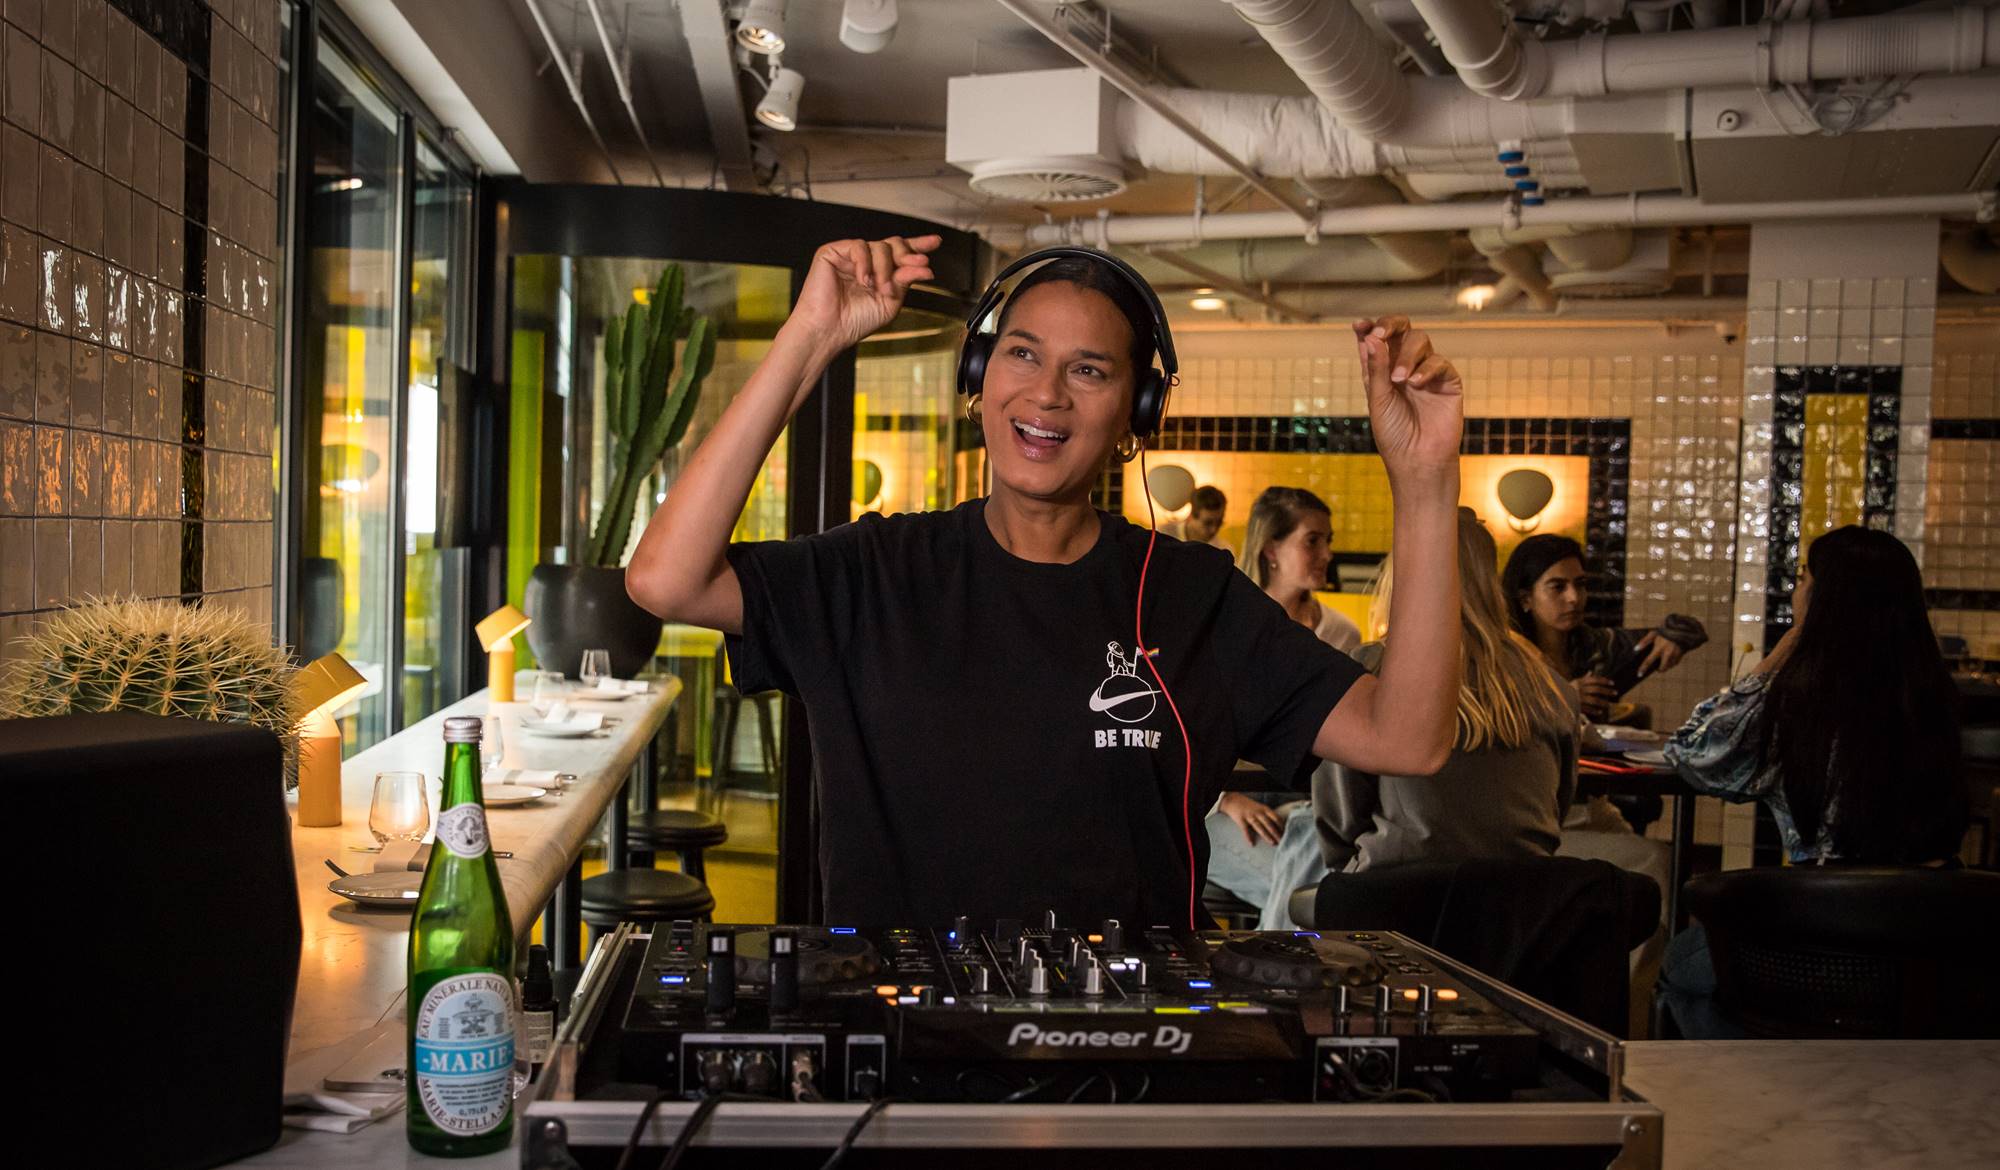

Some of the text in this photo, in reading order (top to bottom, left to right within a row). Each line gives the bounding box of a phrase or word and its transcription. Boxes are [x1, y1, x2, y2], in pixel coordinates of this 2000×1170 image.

[1094, 728, 1161, 749] BE TRUE
[1007, 1022, 1147, 1047] Pioneer
